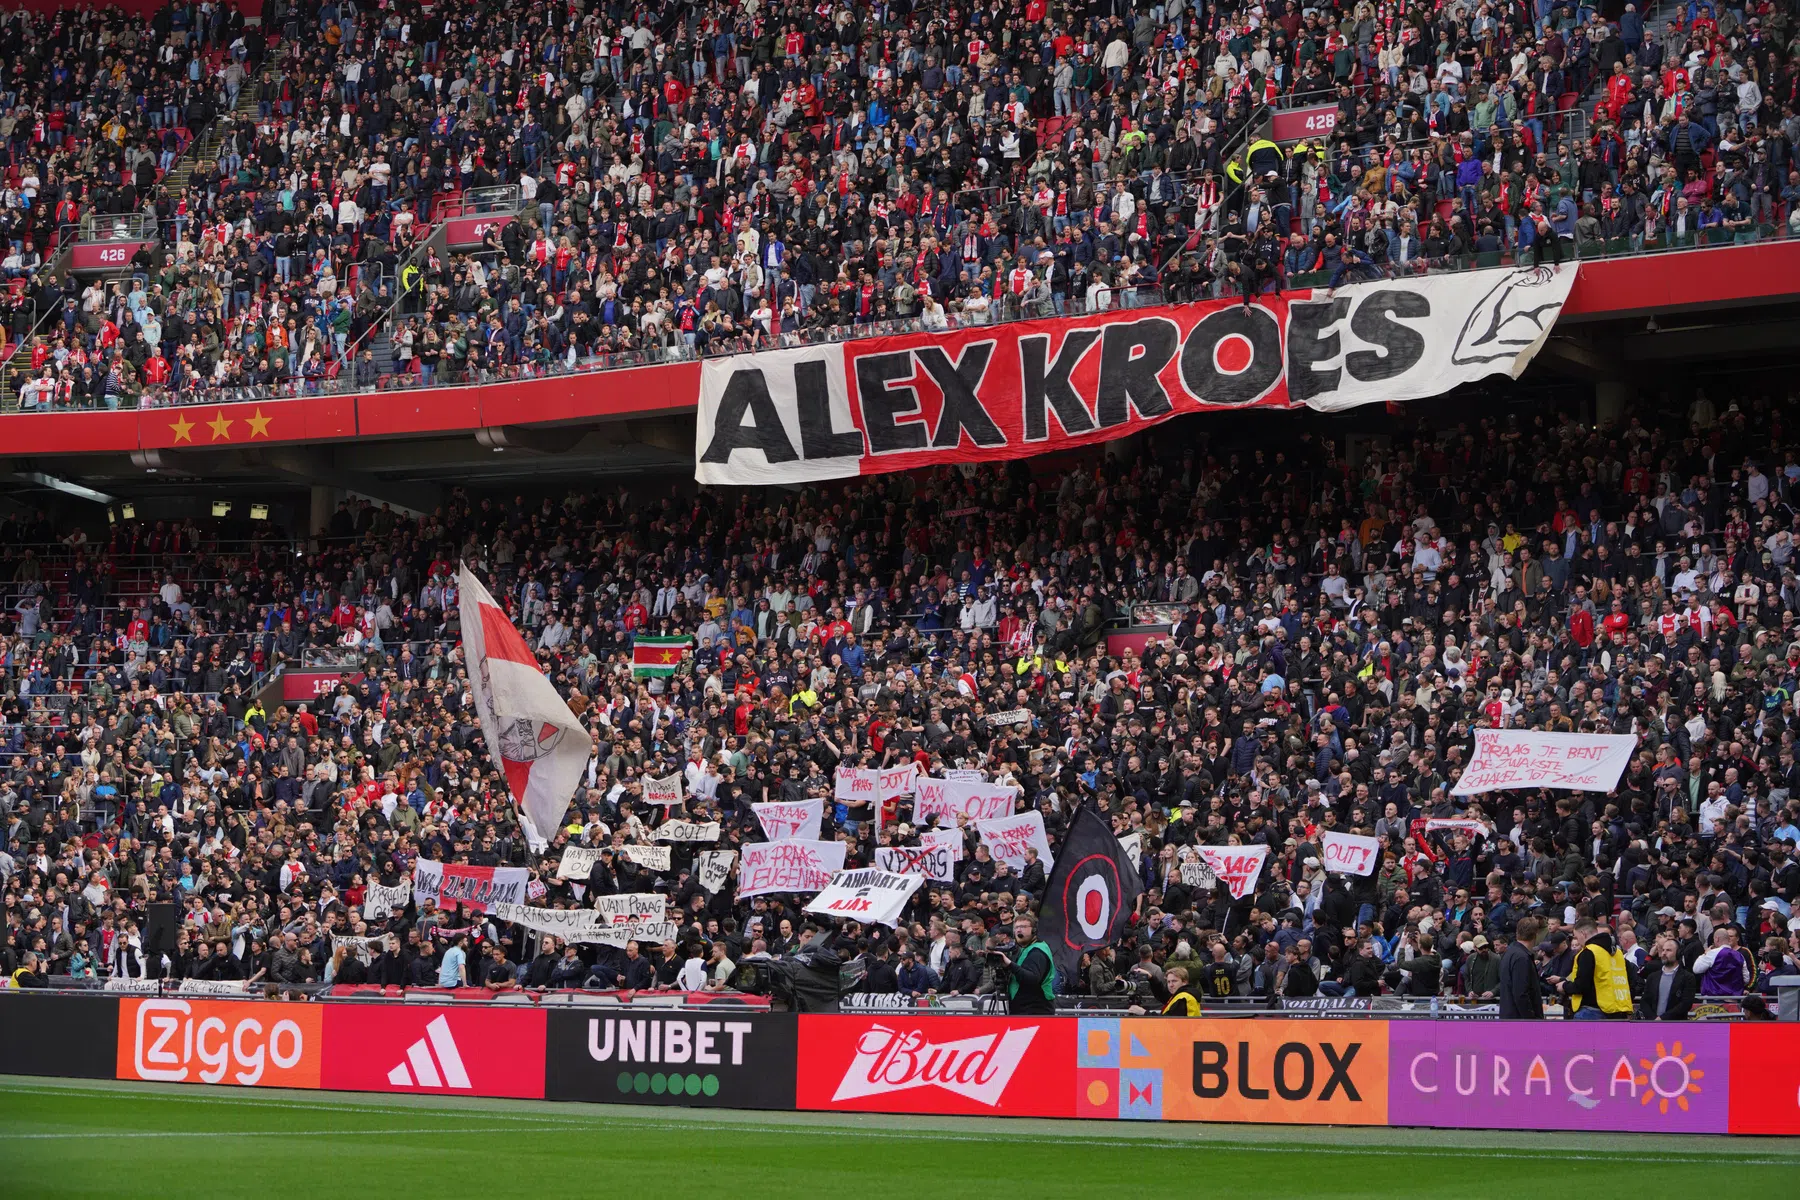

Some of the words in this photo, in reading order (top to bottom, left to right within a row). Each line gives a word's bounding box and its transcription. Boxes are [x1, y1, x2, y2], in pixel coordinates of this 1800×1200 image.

[1306, 113, 1335, 130] 428
[100, 249, 126, 262] 426
[700, 339, 1008, 464] ALEX
[1018, 288, 1431, 443] KROES
[1477, 733, 1499, 744] VAN
[1480, 741, 1531, 760] PRAAG
[1537, 745, 1559, 757] JE
[1567, 745, 1609, 761] BENT
[1471, 760, 1493, 773] DE
[839, 767, 857, 779] VAN
[880, 765, 912, 792] OUT!
[918, 784, 945, 802] VAN
[964, 794, 1013, 821] OUT!
[674, 825, 709, 840] OUT!
[922, 834, 936, 844] VAN
[566, 849, 583, 860] VAN
[742, 849, 768, 868] VAN
[1325, 843, 1372, 872] OUT!
[416, 868, 444, 897] WIJ
[475, 880, 520, 904] AJAX!
[601, 898, 625, 914] VAN
[629, 894, 663, 914] PRAAG
[828, 897, 873, 912] AJAX
[646, 922, 676, 939] OUT!
[1214, 976, 1231, 996] 10
[587, 1017, 752, 1067] UNIBET
[856, 1026, 1010, 1086] Bud
[1192, 1041, 1363, 1102] BLOX
[1409, 1050, 1691, 1110] CURAÇAO
